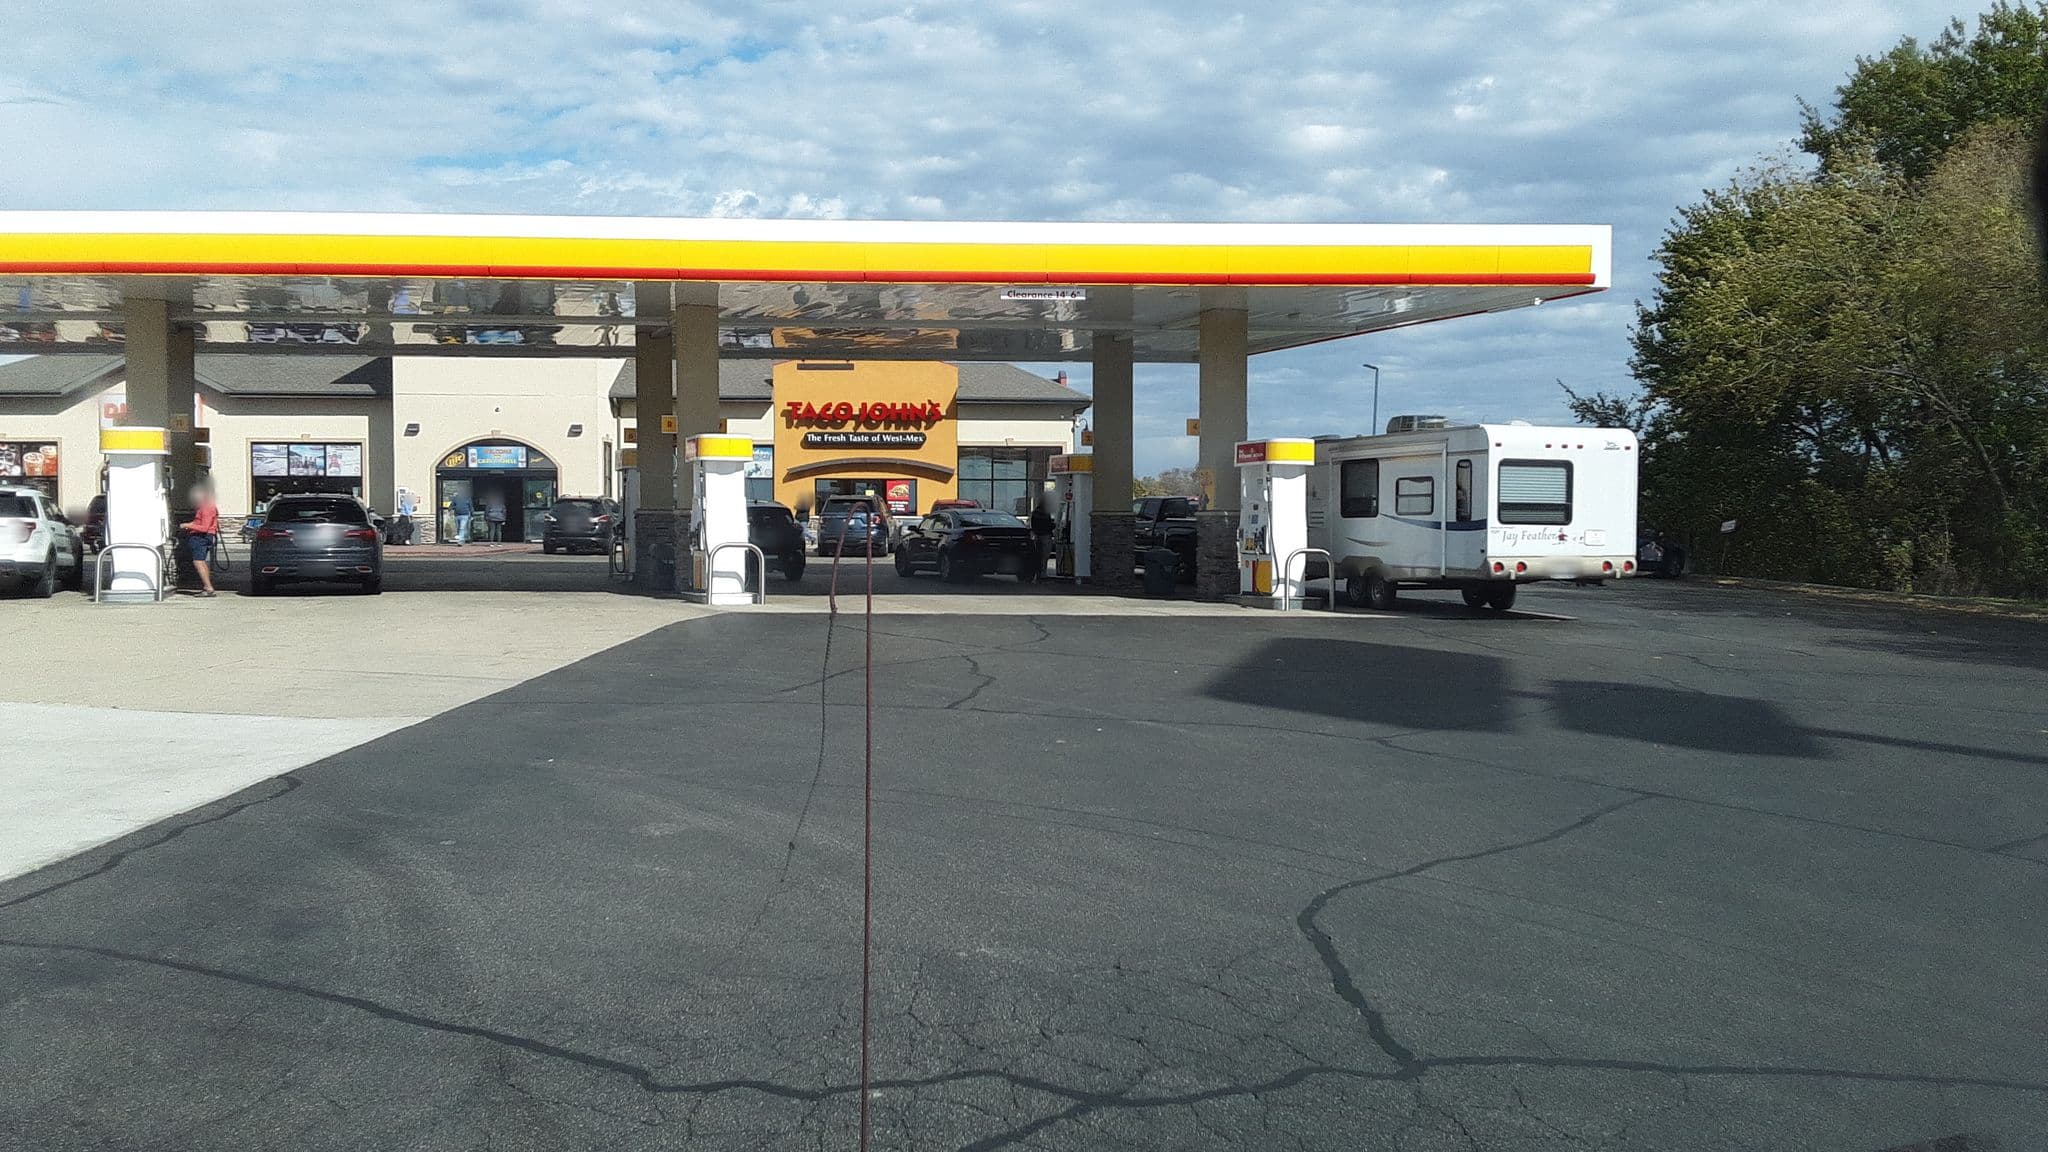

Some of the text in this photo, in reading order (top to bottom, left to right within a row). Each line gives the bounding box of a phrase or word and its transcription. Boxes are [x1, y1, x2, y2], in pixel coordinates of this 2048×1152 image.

[1007, 290, 1053, 298] Clearance
[786, 399, 943, 422] TACO JOHN'S
[807, 433, 924, 442] The Fresh Taste of West-Mex
[1502, 530, 1518, 547] Jay
[1521, 527, 1558, 541] Feather
